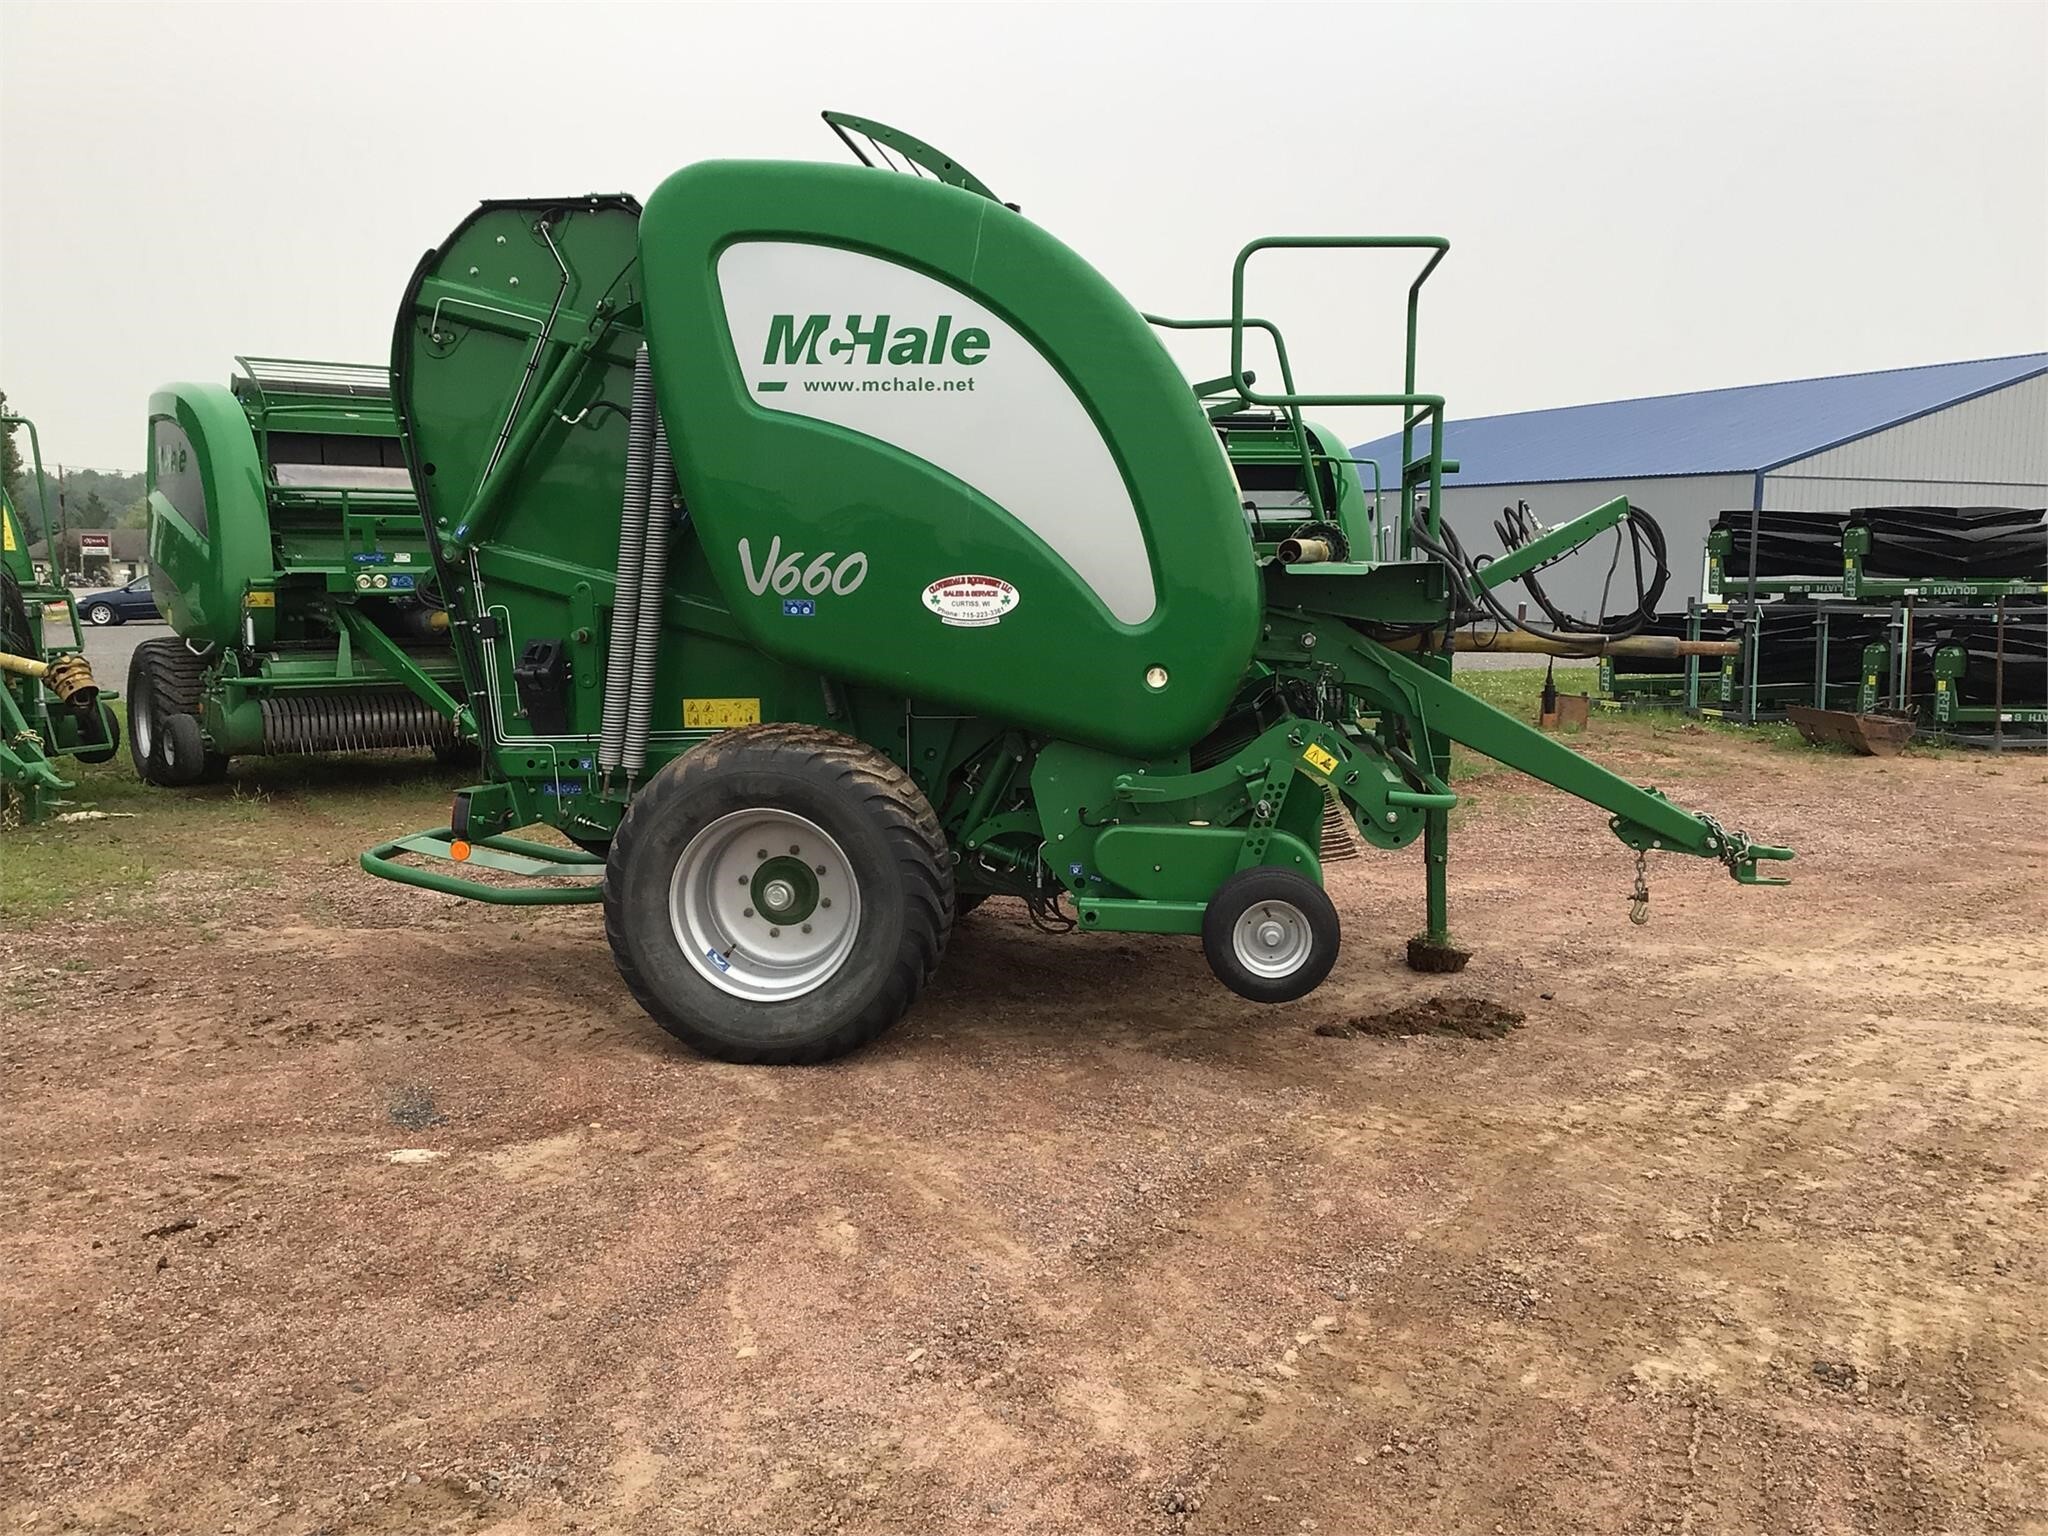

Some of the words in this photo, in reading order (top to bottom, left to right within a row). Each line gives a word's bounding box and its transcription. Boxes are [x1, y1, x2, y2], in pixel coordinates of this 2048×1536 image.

[763, 315, 991, 366] McHale
[804, 377, 975, 392] www.mchale.net
[738, 535, 868, 596] V660
[1933, 585, 1978, 595] GOLIATH
